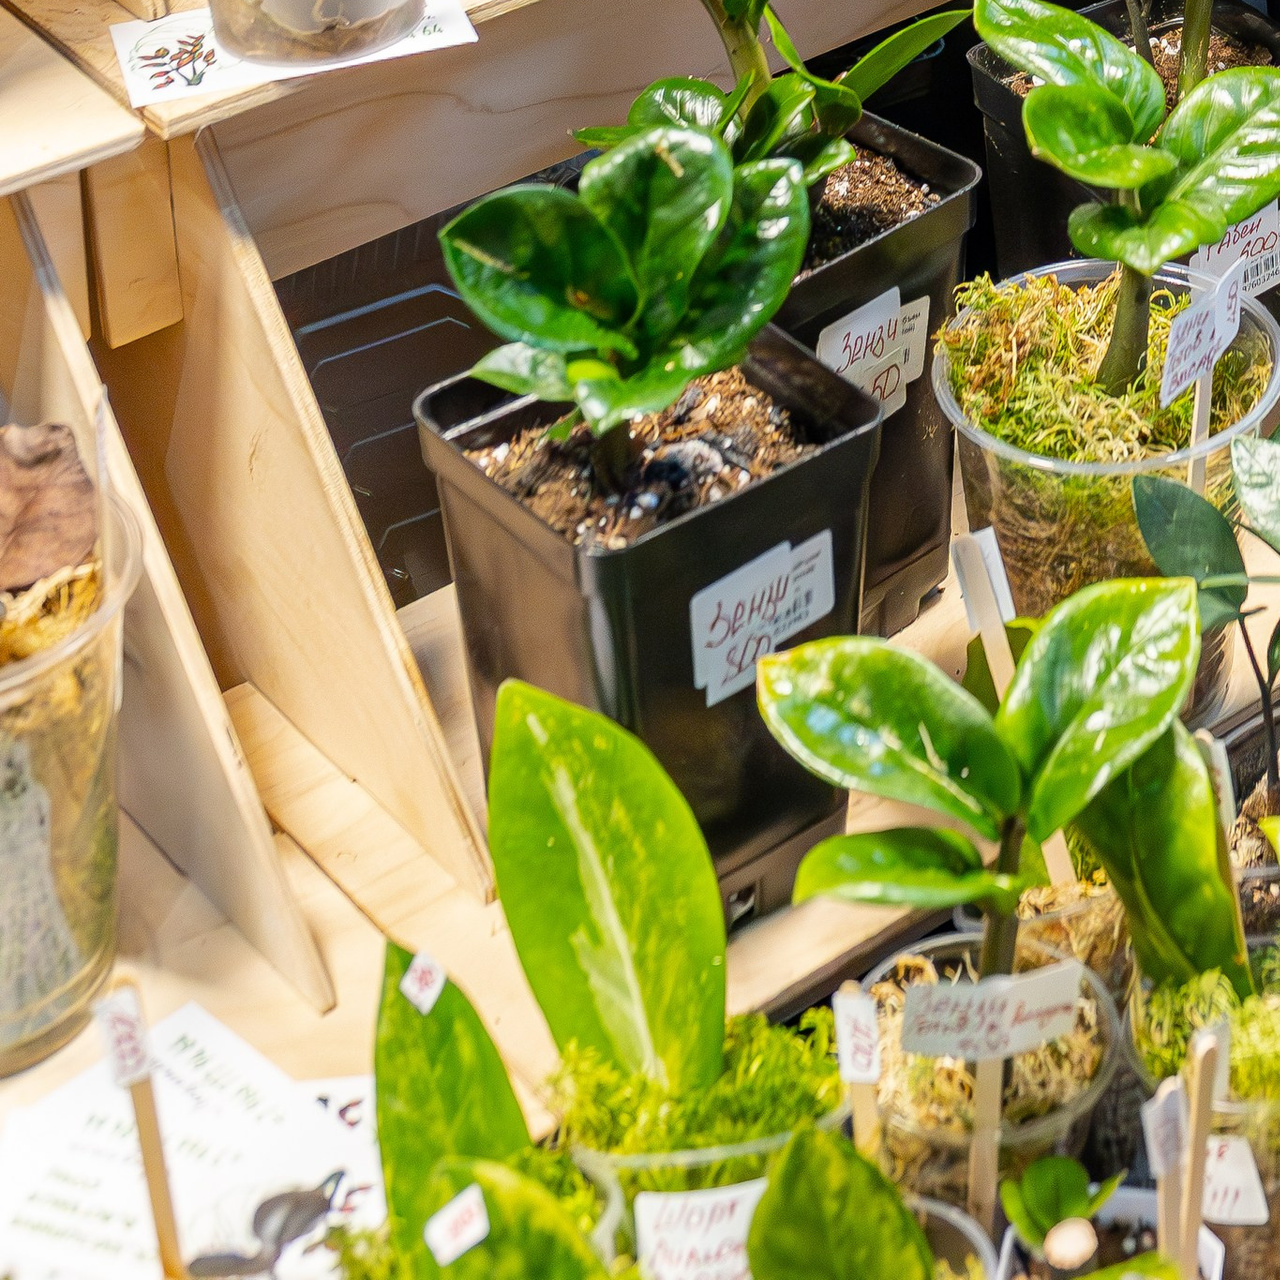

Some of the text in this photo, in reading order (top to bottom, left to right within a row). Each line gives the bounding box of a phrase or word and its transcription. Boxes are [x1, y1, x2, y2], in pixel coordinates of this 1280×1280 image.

[835, 318, 899, 375] Зензи
[861, 362, 901, 402] 50
[704, 573, 790, 649] Зензи
